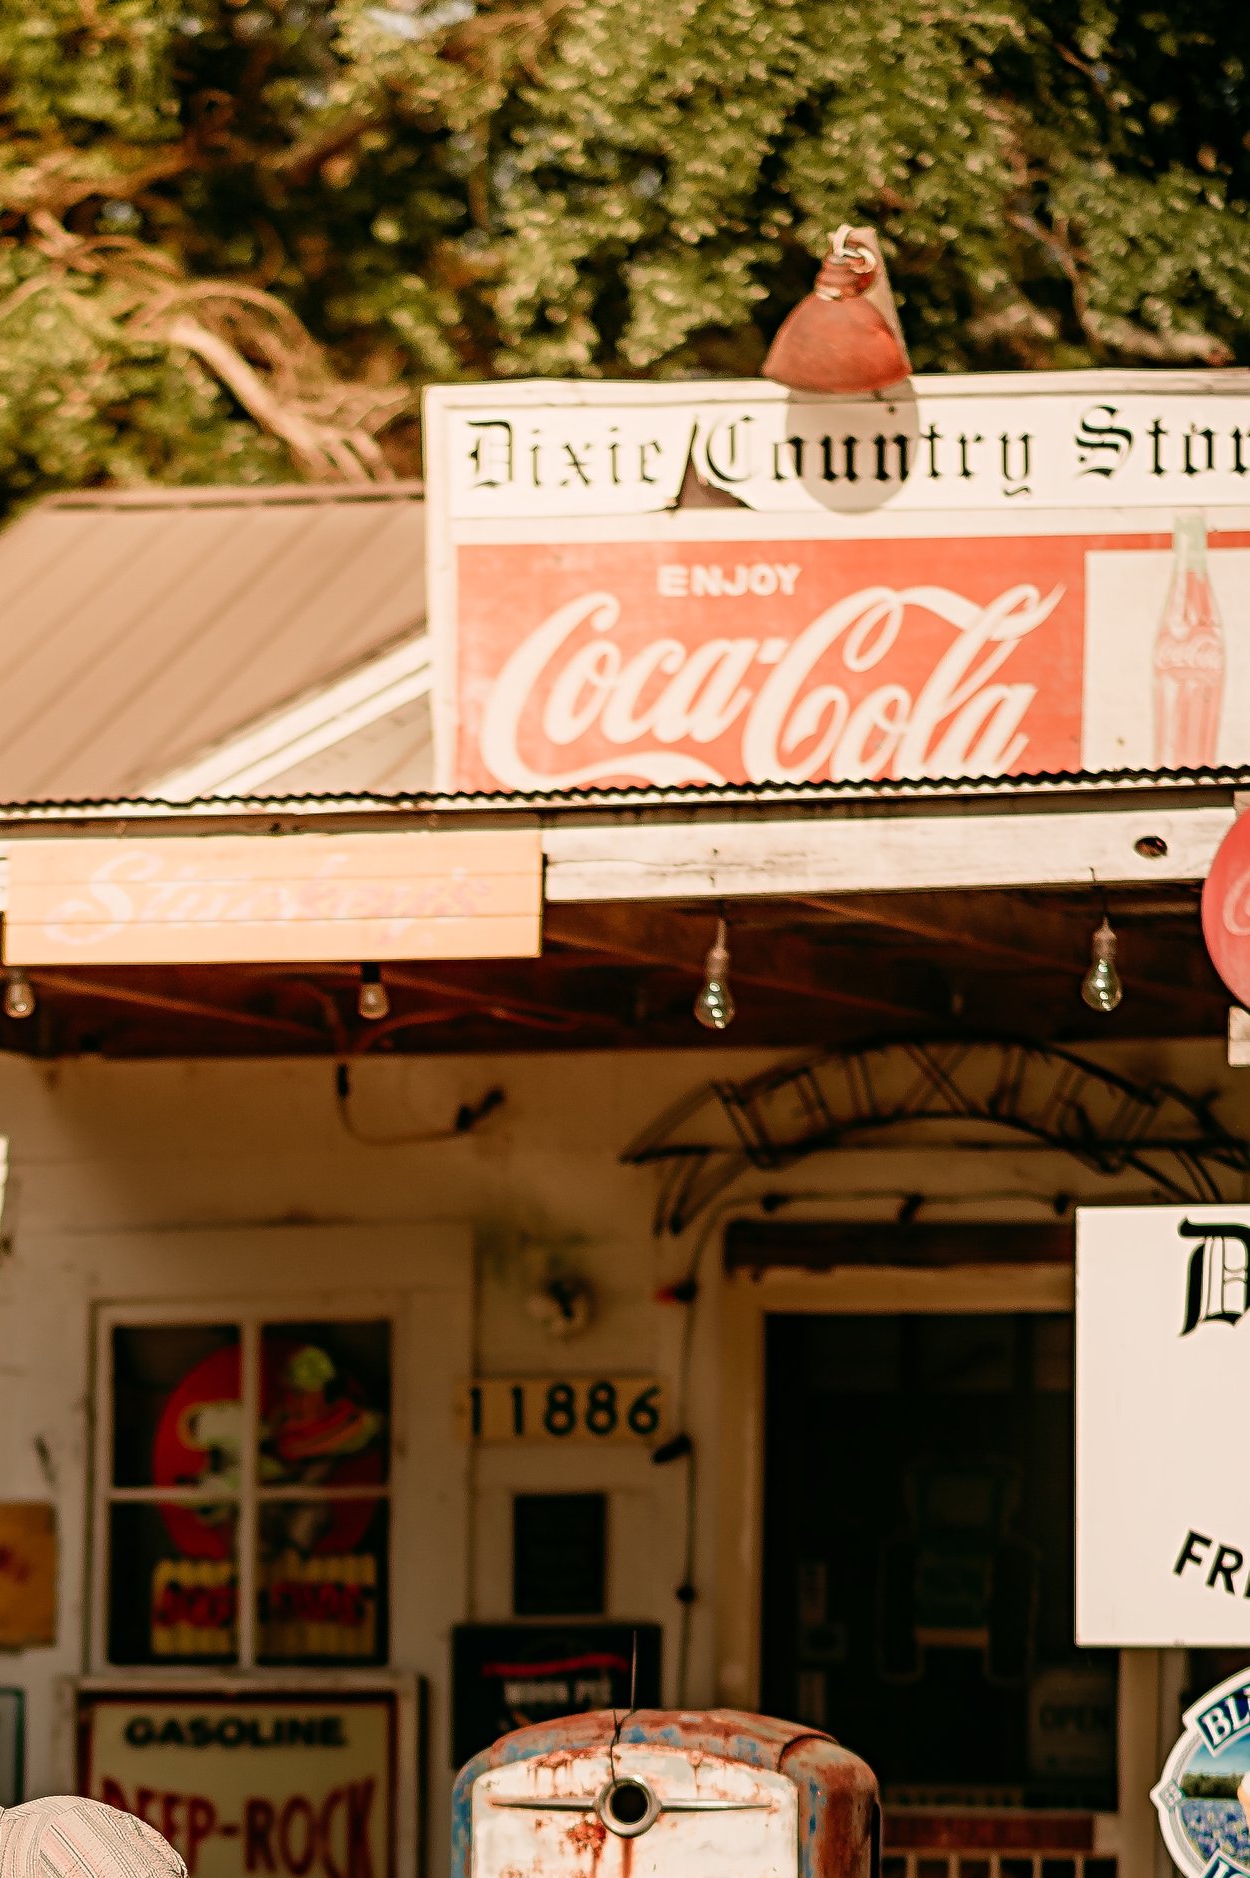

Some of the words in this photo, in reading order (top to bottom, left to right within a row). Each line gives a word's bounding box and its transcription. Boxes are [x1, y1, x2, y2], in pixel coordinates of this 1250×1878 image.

[465, 418, 664, 489] Dixie
[705, 415, 1036, 499] Country
[657, 562, 802, 598] ENJOY
[480, 582, 1066, 788] Coca-Cola
[470, 1381, 662, 1436] 11886
[125, 1715, 347, 1748] GASOLINE
